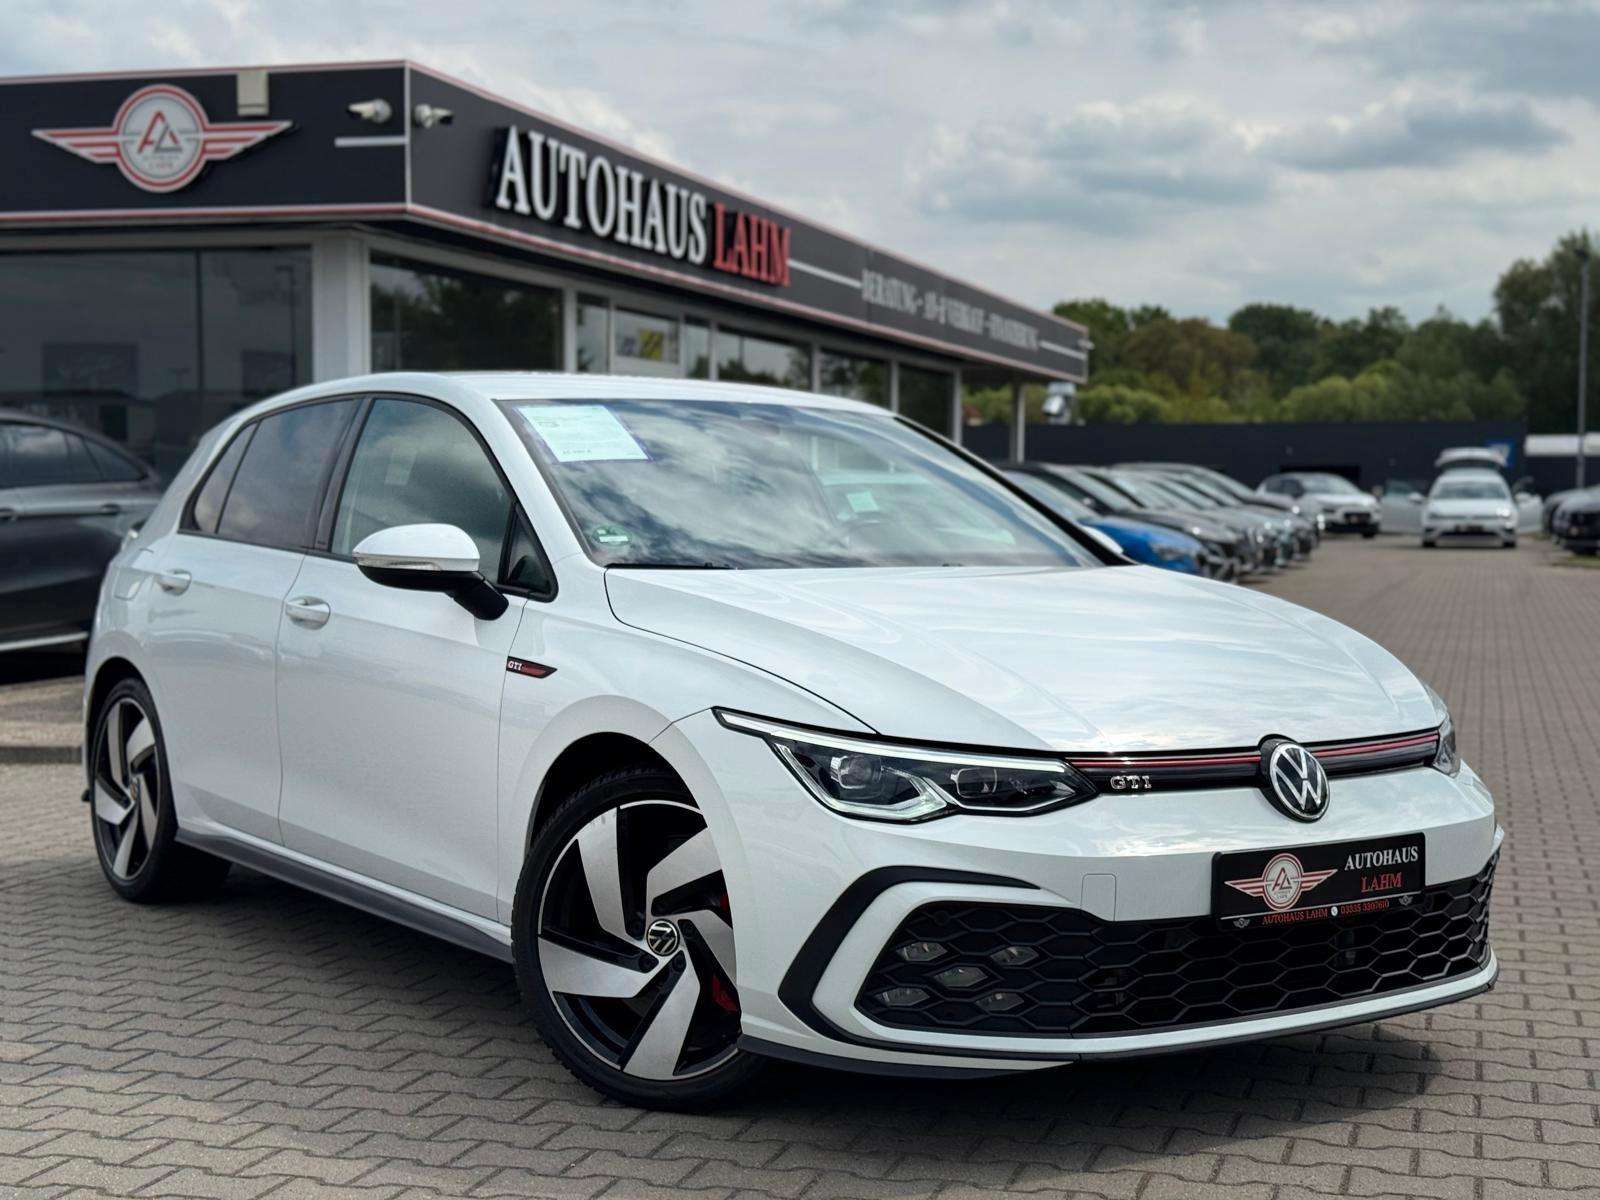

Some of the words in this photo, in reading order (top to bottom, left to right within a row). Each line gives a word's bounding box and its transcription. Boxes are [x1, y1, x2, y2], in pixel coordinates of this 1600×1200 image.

[496, 125, 706, 264] AUTOHAUS
[713, 201, 791, 287] LAHM
[508, 660, 522, 671] GTI
[1110, 775, 1152, 790] GTI
[1344, 846, 1419, 871] AUTOHAUS
[1361, 872, 1402, 893] LAHM
[1262, 911, 1305, 926] AUTOHAUS
[1306, 908, 1328, 920] LAHM
